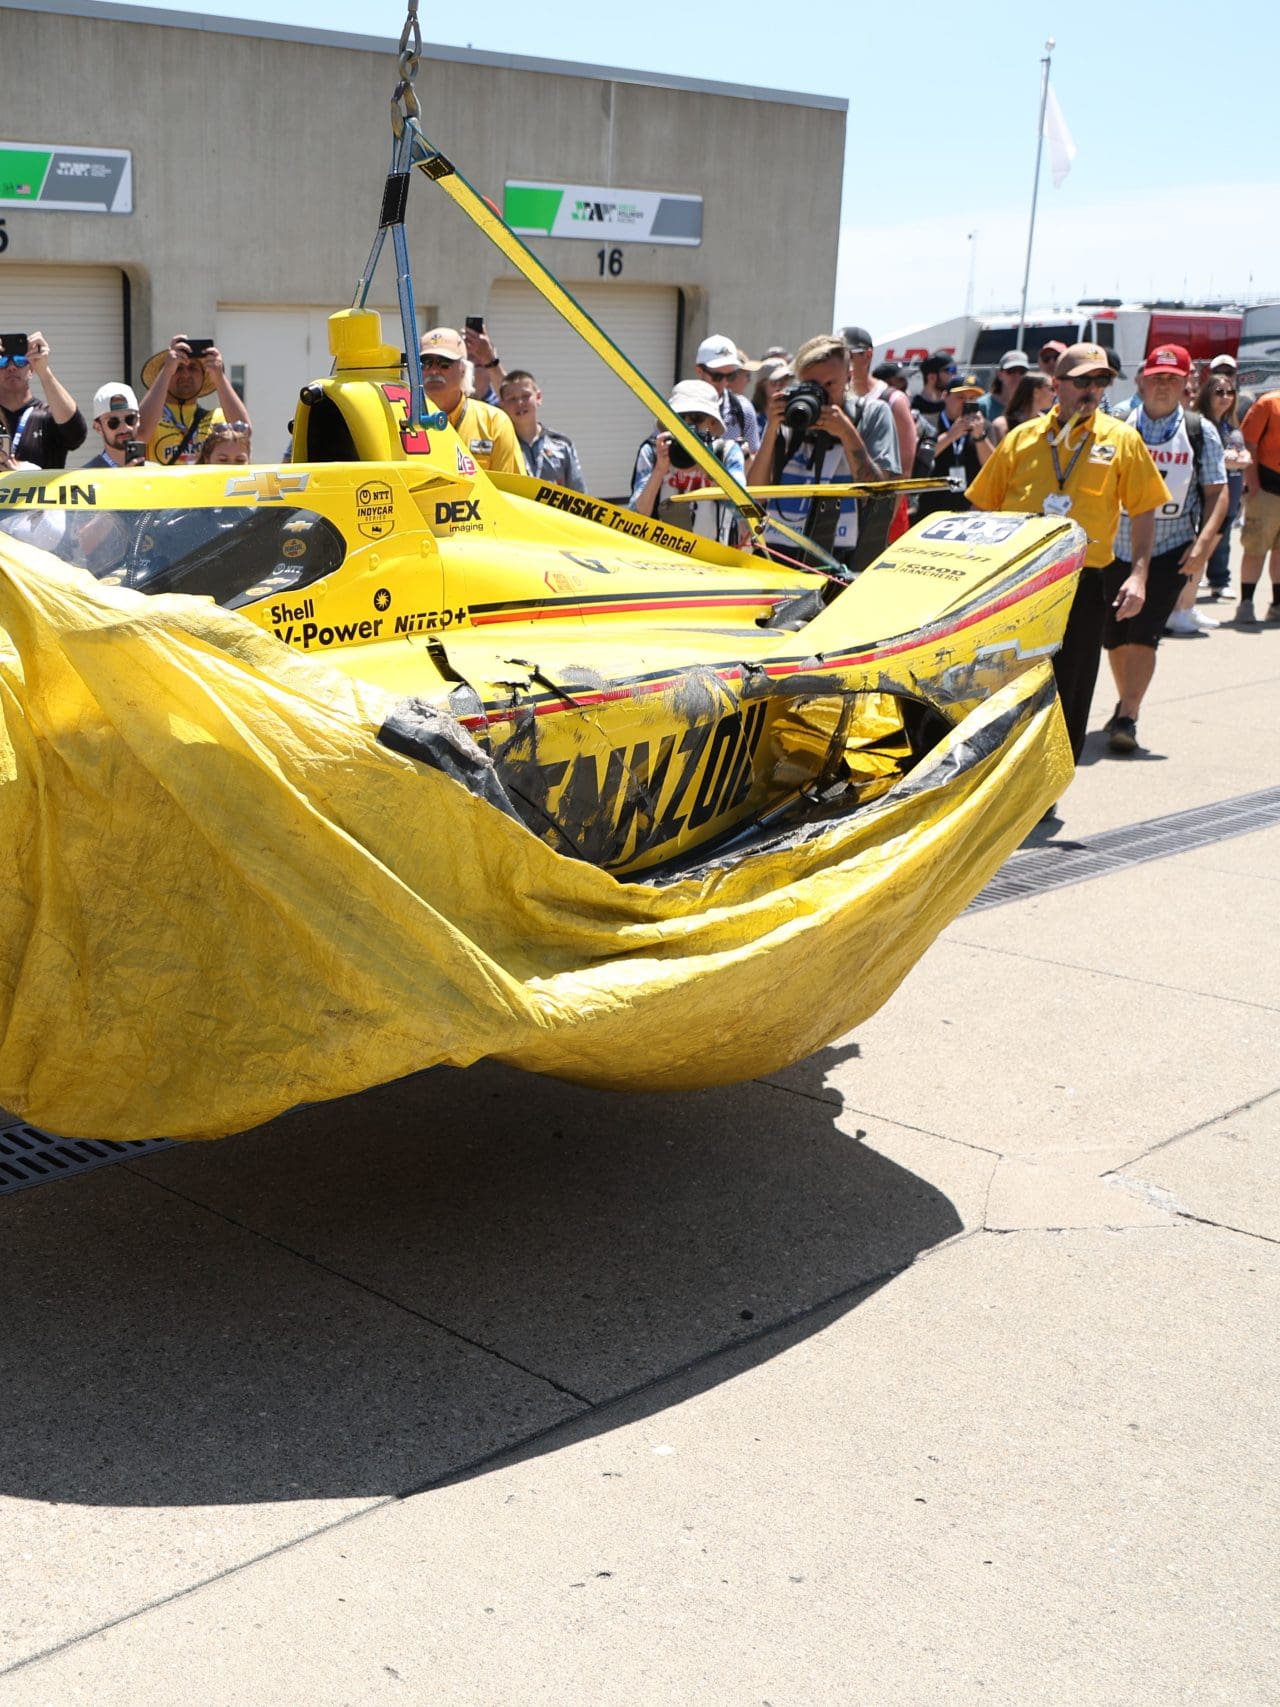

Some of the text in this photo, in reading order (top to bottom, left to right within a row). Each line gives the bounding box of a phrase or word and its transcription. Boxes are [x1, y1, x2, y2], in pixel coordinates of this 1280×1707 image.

[597, 248, 623, 276] 16
[372, 490, 390, 501] NTT
[357, 505, 394, 517] INDYCAR
[435, 499, 482, 525] DEX
[534, 486, 698, 555] PENSKE Truck Rental
[449, 522, 484, 533] imaging
[899, 567, 961, 582] RANCHERS
[906, 562, 968, 577] GOOD
[271, 599, 315, 625] Shell
[274, 618, 383, 649] V-Power
